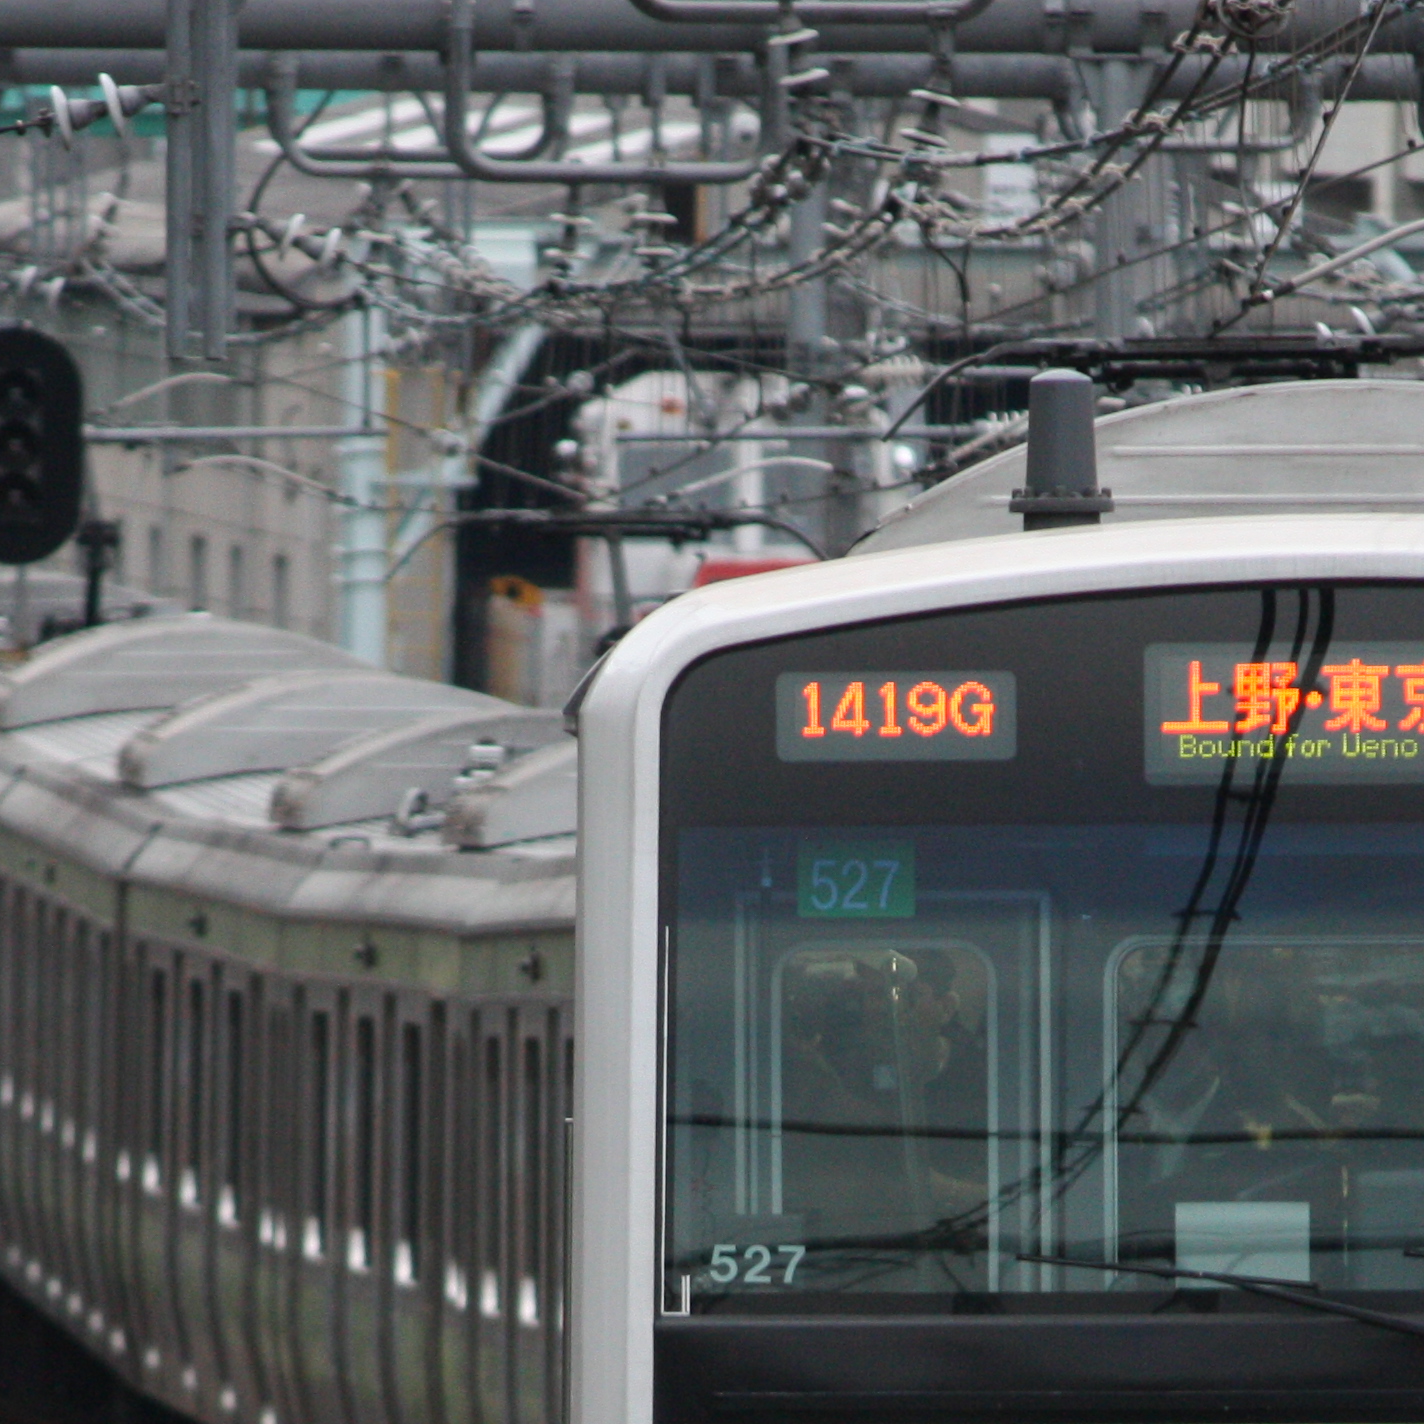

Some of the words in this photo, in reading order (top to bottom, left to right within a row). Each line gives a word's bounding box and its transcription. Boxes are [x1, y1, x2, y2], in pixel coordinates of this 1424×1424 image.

[802, 680, 996, 737] 1419G
[1179, 733, 1275, 758] Bound
[1285, 733, 1331, 758] for
[1342, 733, 1418, 758] Ueno
[811, 859, 900, 910] 527
[709, 1244, 807, 1284] 527
